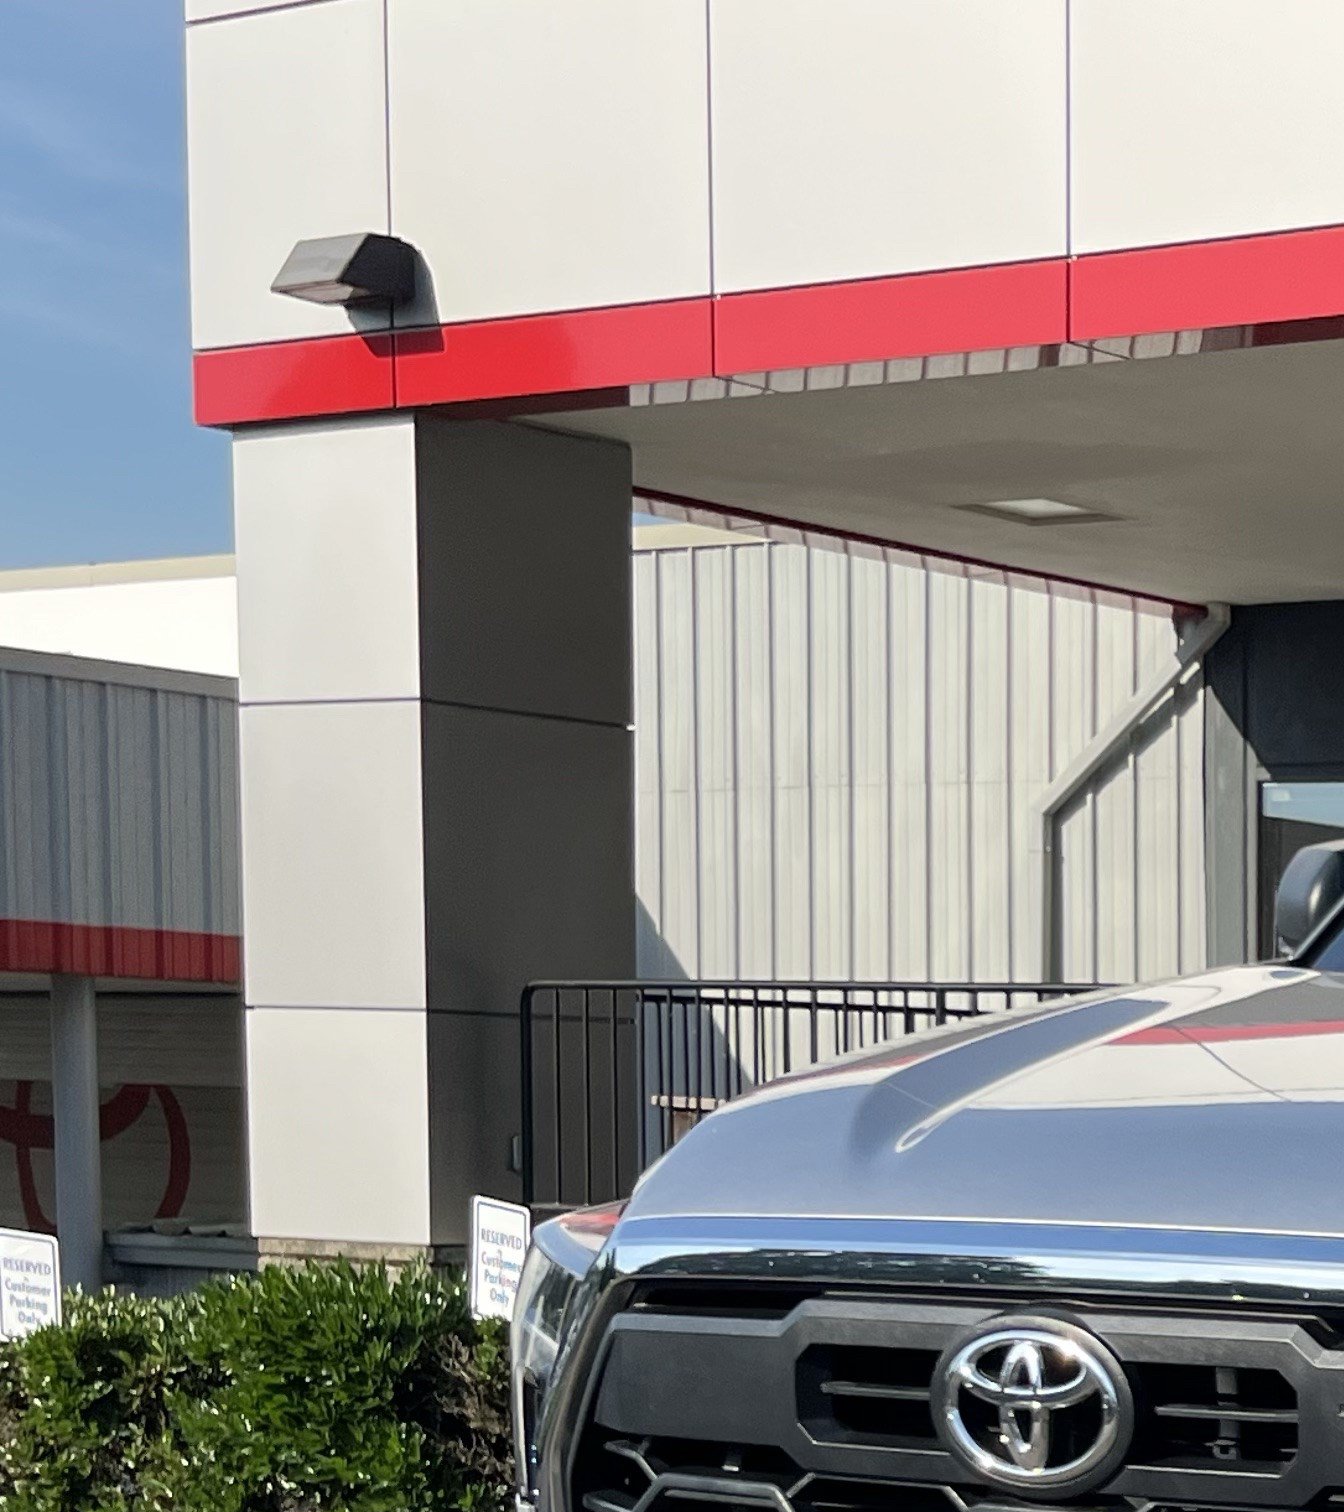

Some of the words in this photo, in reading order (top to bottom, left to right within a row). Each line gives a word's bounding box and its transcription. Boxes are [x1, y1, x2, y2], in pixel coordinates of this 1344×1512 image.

[481, 1228, 522, 1250] RESERVED
[3, 1256, 52, 1275] RESERVED
[4, 1276, 51, 1297] Customer
[484, 1268, 518, 1293] Parking
[9, 1293, 48, 1316] Parking
[489, 1287, 510, 1307] Only
